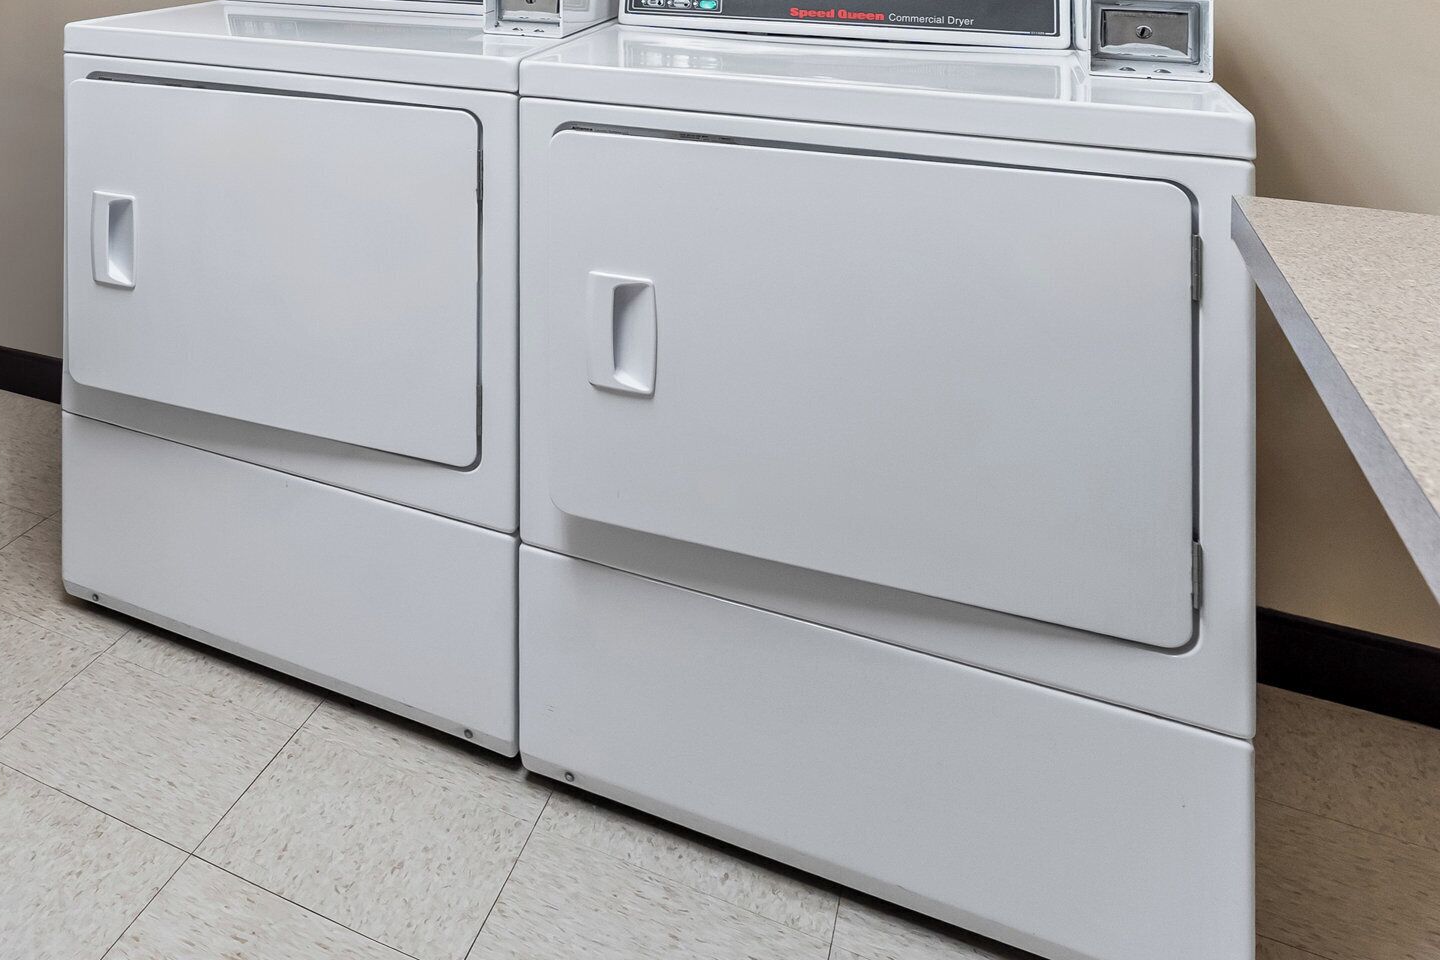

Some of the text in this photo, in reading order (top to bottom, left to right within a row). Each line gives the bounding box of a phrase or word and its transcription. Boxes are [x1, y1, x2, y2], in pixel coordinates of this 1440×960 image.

[789, 7, 974, 27] Speed Queen Commercial Dryer
